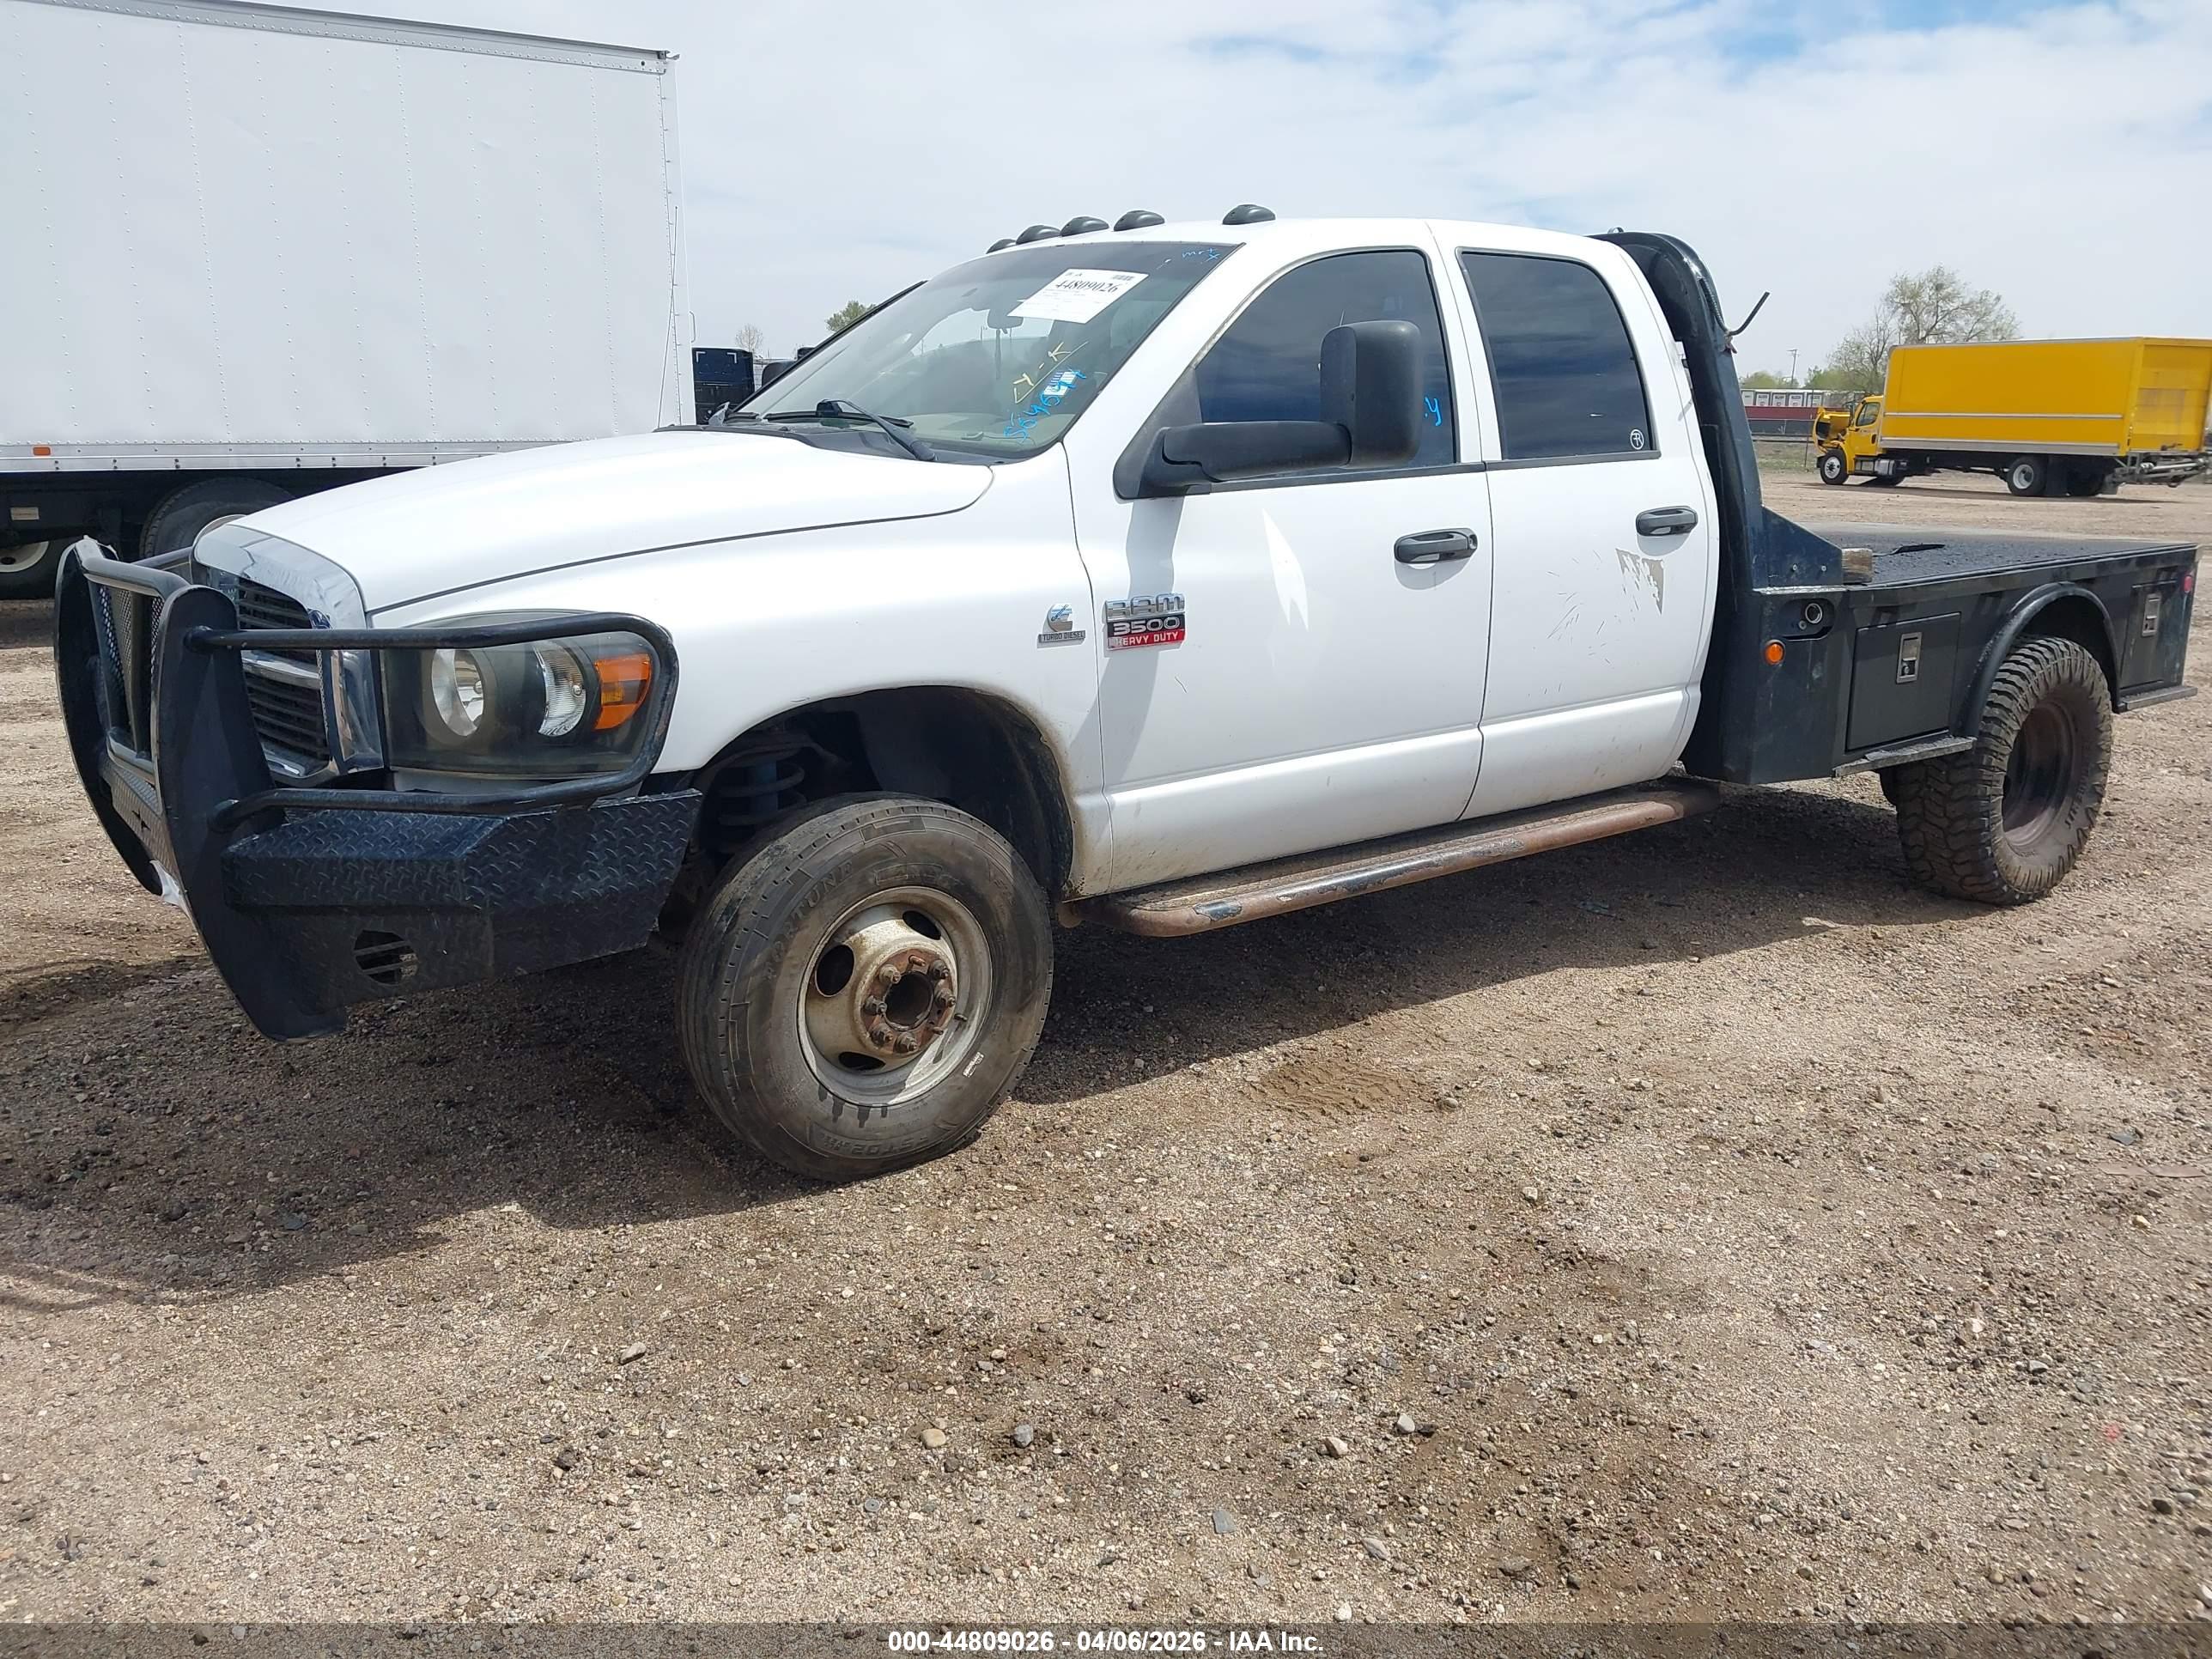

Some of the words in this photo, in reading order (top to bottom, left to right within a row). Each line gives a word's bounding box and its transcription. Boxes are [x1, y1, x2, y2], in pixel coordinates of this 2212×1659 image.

[1055, 280, 1120, 293] 44809026
[1113, 617, 1181, 636] 3500
[1042, 633, 1063, 641] TURBO
[1064, 630, 1084, 640] DIESEL
[1115, 635, 1150, 647] HEAVY
[1153, 631, 1179, 643] DUTY
